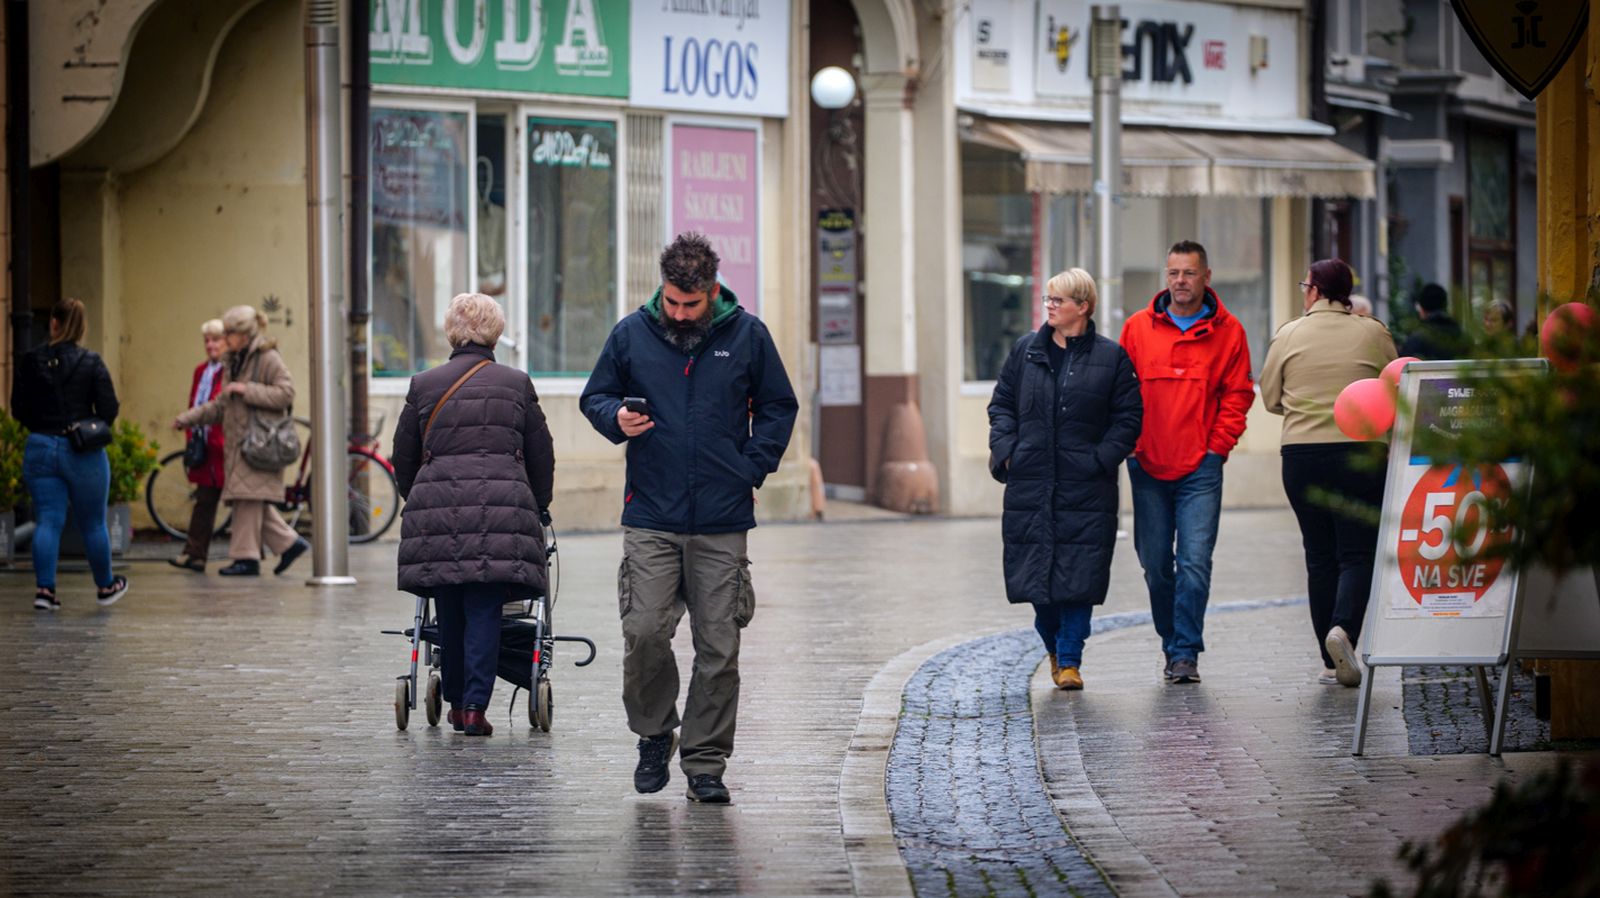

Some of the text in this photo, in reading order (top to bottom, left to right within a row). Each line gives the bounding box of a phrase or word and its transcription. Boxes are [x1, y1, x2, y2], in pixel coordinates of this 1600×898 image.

[662, 36, 759, 101] LOGOS
[684, 184, 744, 223] ŠKOLSKI
[1400, 490, 1518, 560] -50
[1413, 564, 1486, 588] NA SVE
